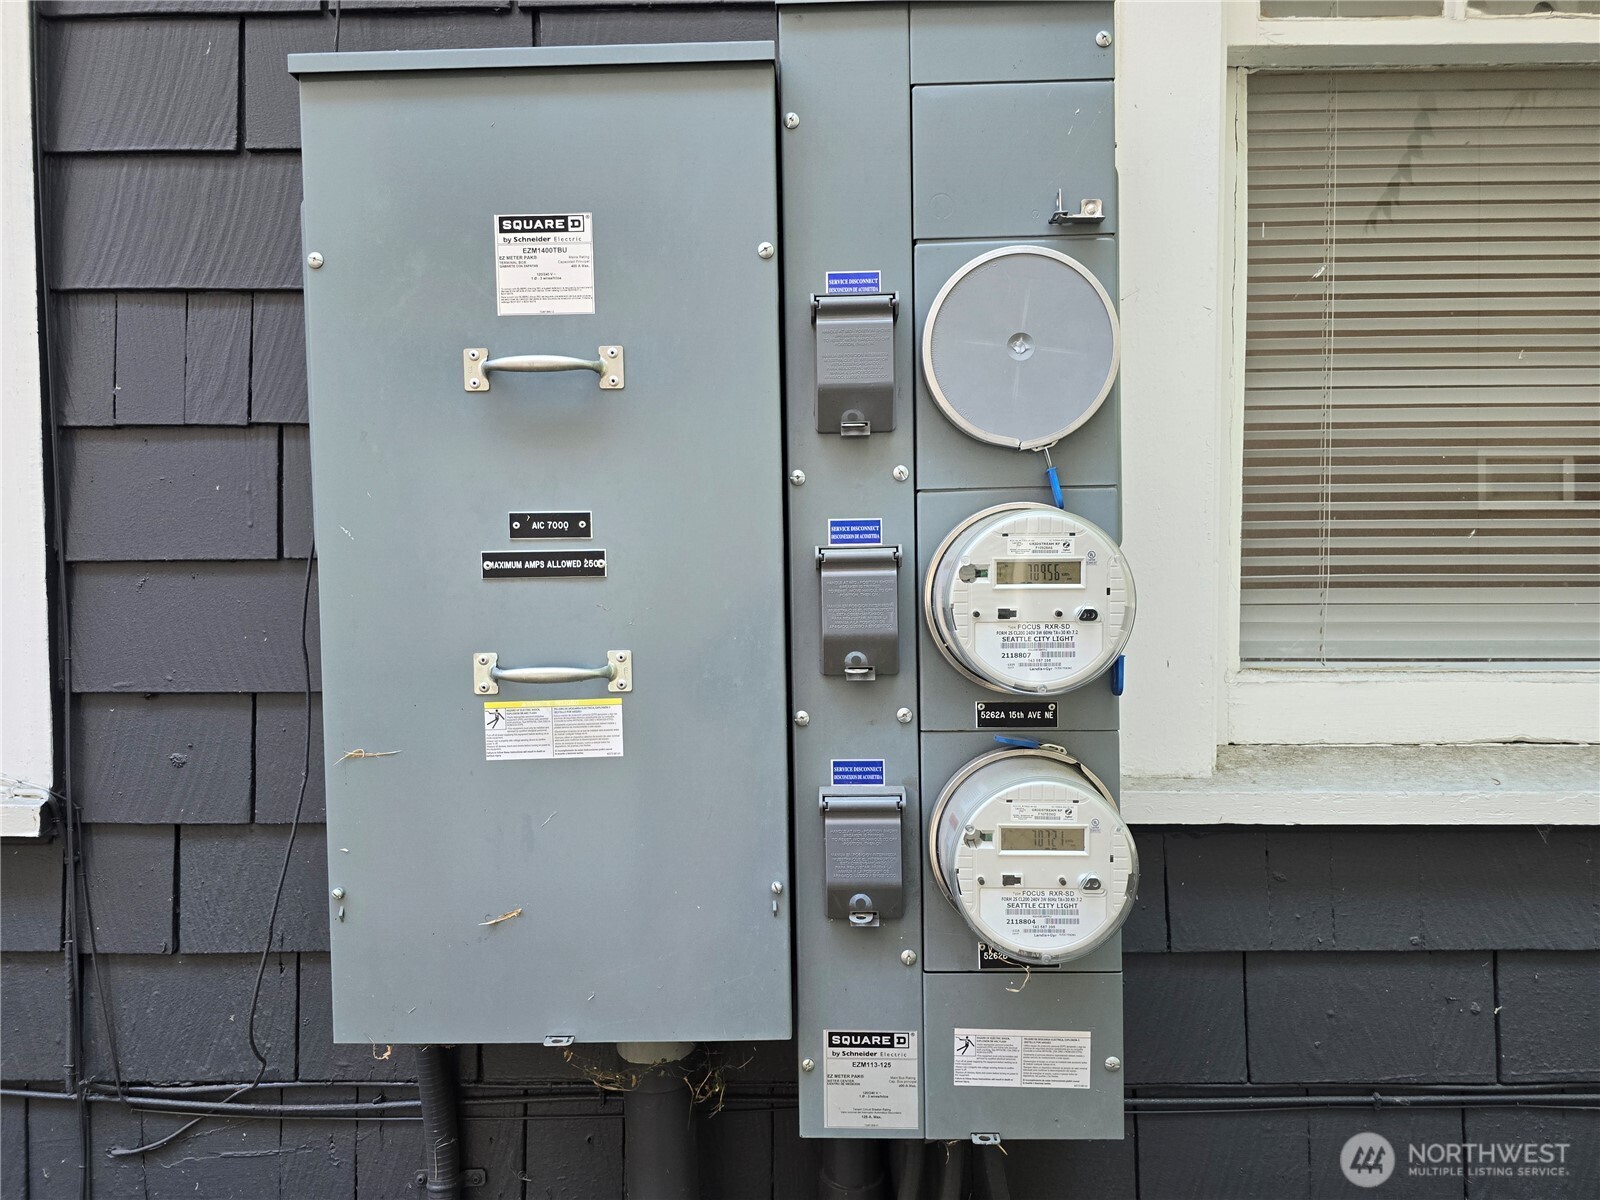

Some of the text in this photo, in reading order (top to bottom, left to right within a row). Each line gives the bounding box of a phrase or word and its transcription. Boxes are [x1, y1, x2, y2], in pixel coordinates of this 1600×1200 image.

[502, 218, 582, 231] SQUARE D
[503, 236, 512, 244] by
[547, 521, 569, 529] 7000
[490, 561, 522, 569] MAXIMUM
[524, 561, 545, 569] AMPS
[547, 560, 582, 568] ALLOWED
[832, 1036, 906, 1046] SQUARE D
